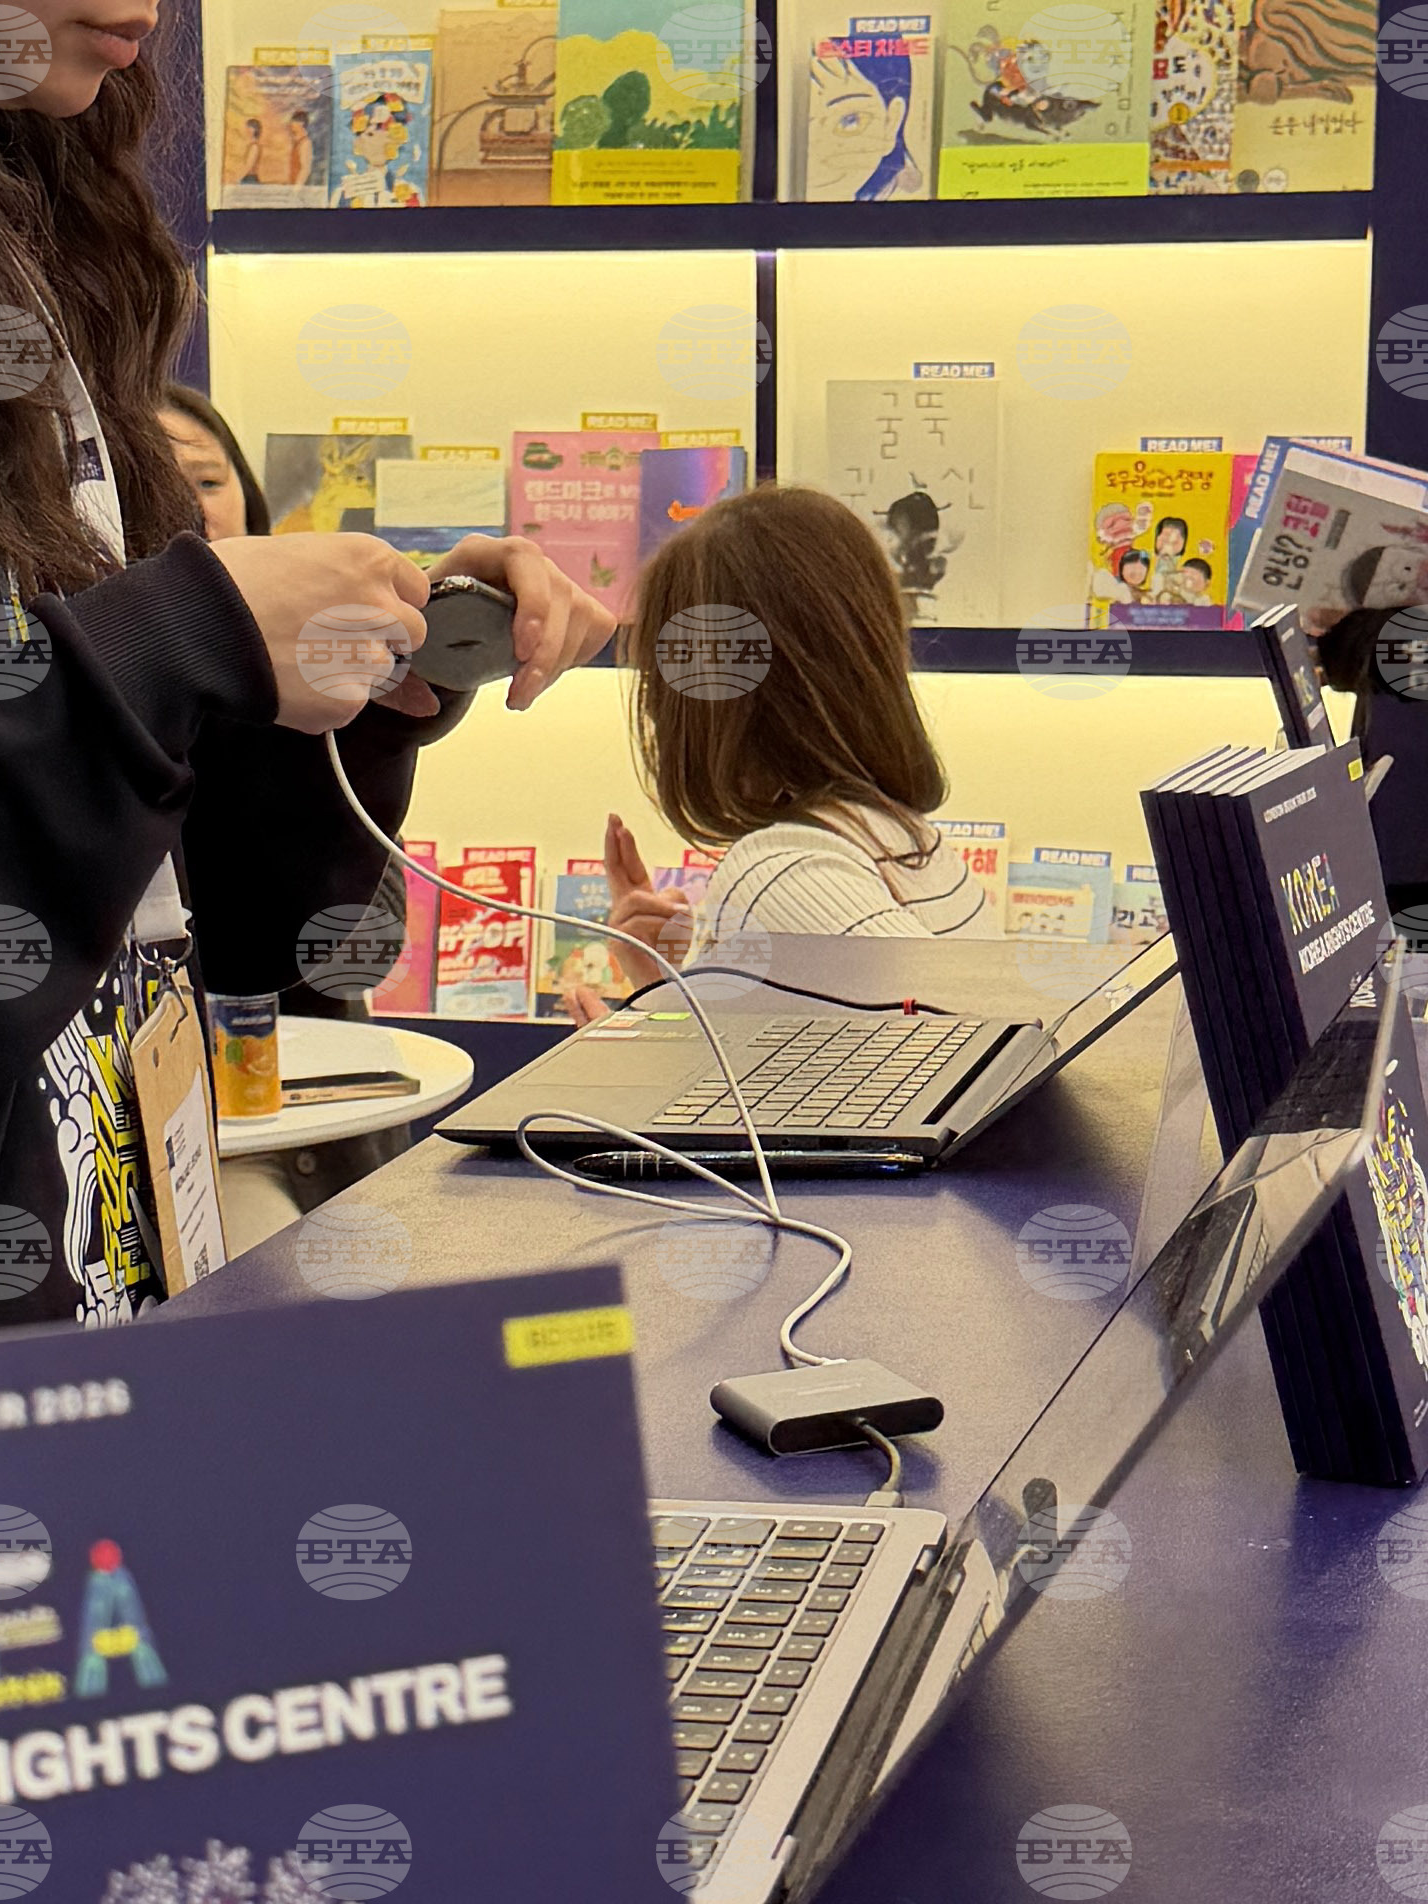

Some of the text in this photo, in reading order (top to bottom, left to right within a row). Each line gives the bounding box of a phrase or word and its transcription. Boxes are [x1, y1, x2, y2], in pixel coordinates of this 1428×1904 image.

[920, 365, 961, 378] READ
[875, 392, 951, 460] 굴뚝
[1147, 438, 1190, 452] READ
[223, 1654, 513, 1760] CENTRE
